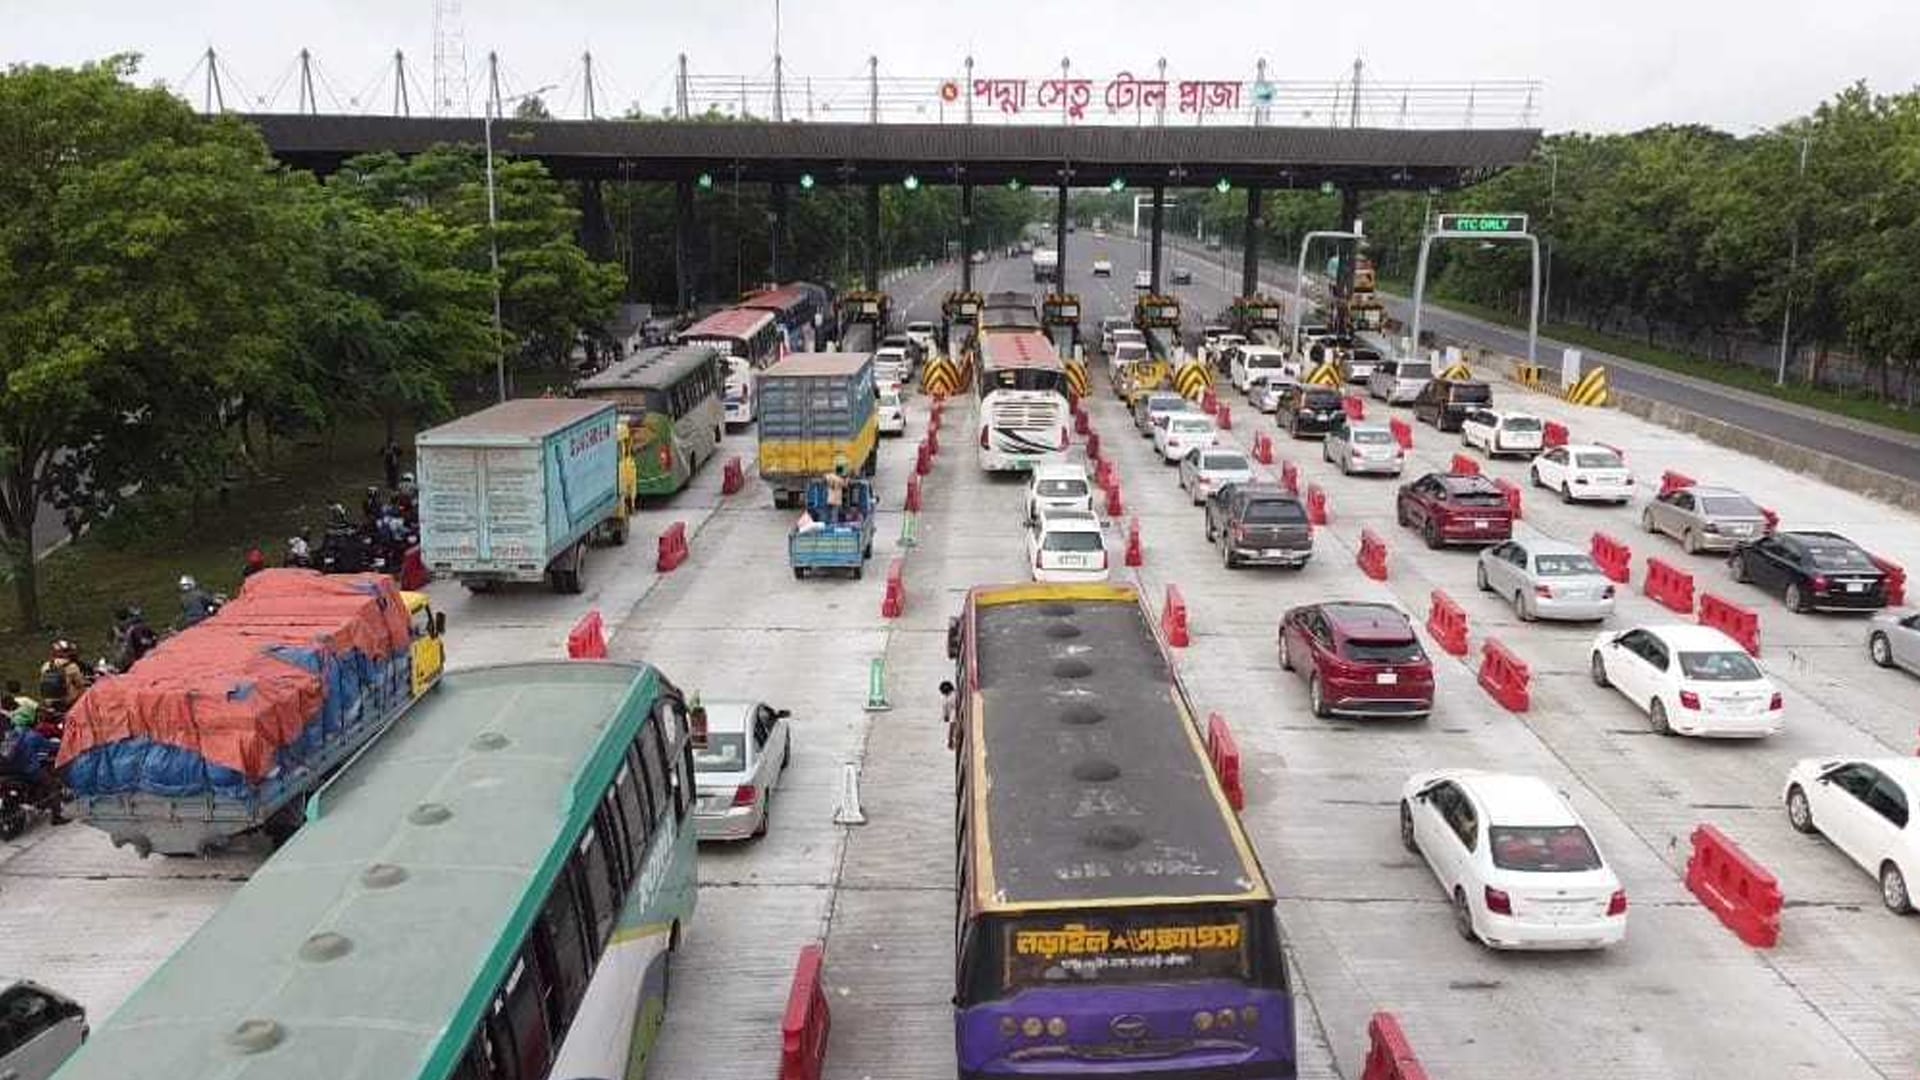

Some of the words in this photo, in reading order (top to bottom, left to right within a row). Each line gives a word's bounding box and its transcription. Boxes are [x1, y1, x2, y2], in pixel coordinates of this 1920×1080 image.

[973, 79, 1026, 113] পদ্মা
[1037, 79, 1092, 119] সেতু
[1105, 72, 1167, 110] টোল
[1179, 81, 1242, 114] প্লাজা
[1479, 219, 1509, 230] ONLY
[1016, 924, 1110, 959] নড়াইল
